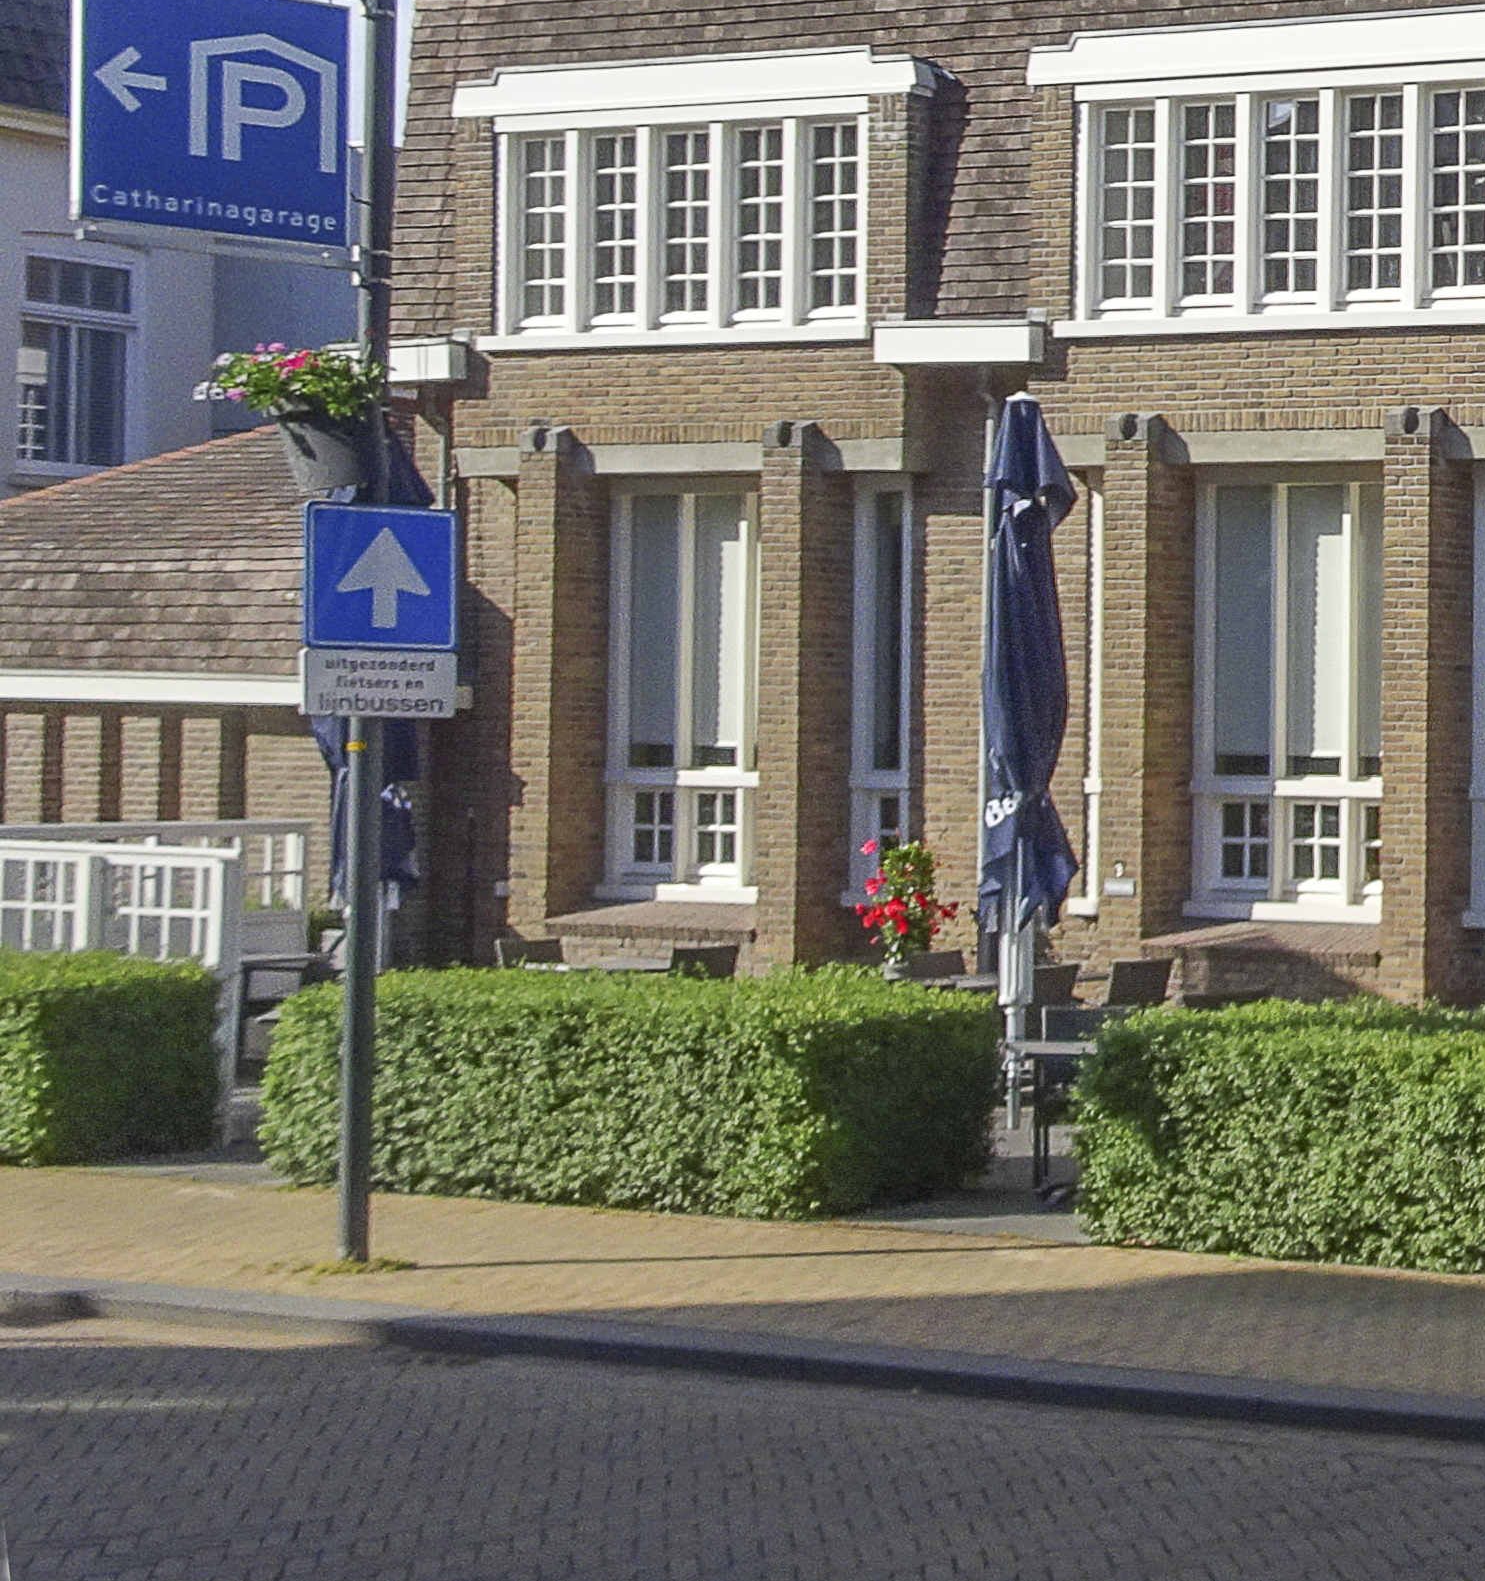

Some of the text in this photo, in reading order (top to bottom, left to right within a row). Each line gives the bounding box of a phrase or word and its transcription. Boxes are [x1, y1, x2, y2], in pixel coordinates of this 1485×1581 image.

[221, 60, 306, 162] P
[90, 183, 338, 234] Catharinagarage
[324, 658, 436, 673] uitgezonderd
[336, 675, 425, 690] fietsers en
[318, 693, 444, 713] lijnbussen
